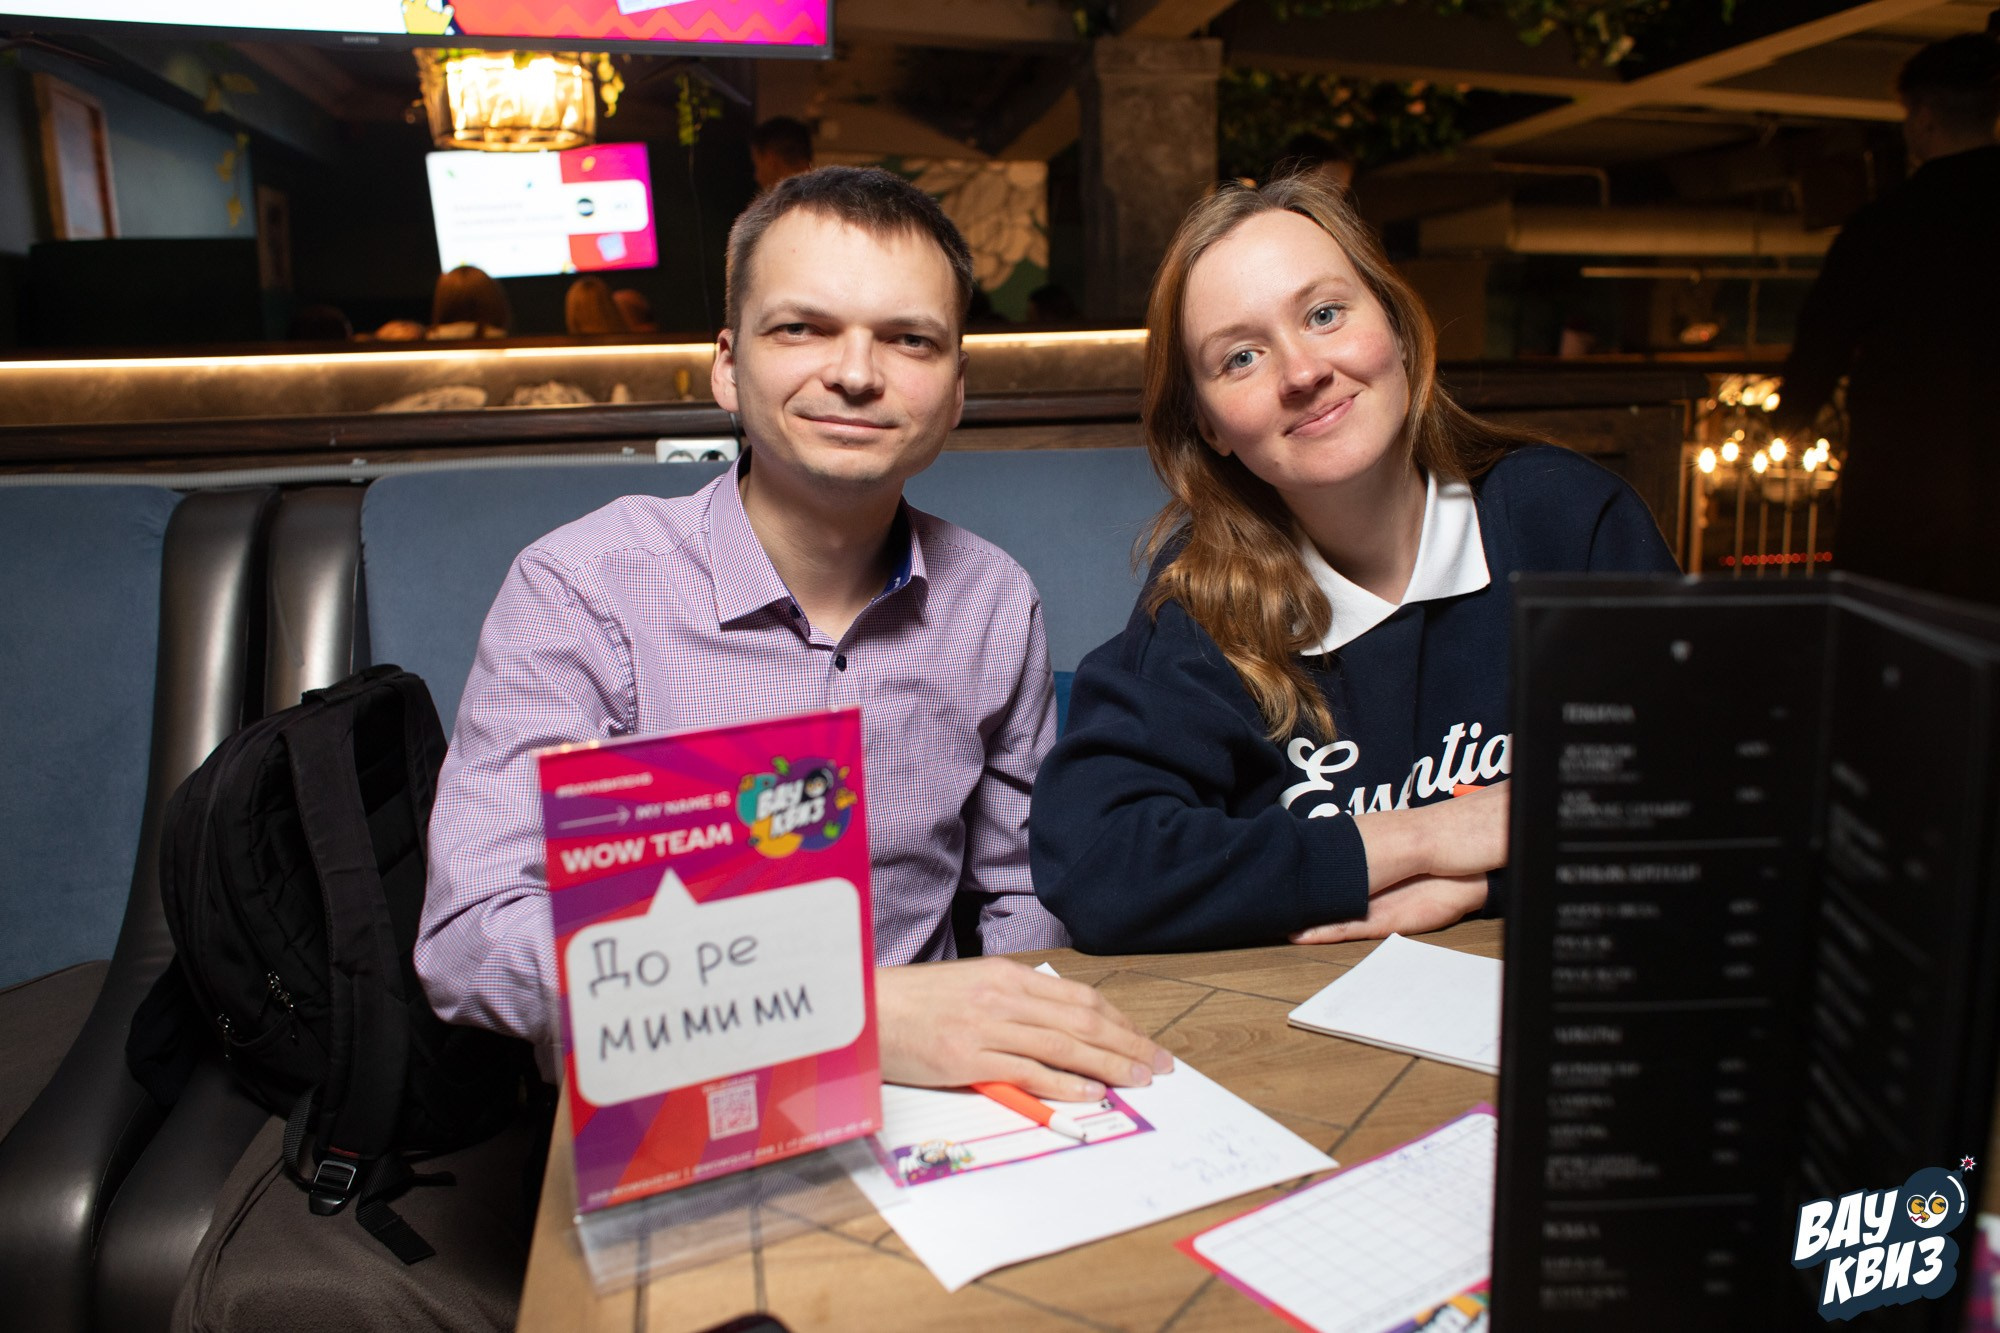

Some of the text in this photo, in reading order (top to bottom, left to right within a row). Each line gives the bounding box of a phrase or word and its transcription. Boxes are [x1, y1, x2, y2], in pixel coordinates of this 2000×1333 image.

[635, 790, 732, 821] MY NAME IS
[560, 821, 734, 874] WOW TEAM
[588, 933, 759, 999] До ре
